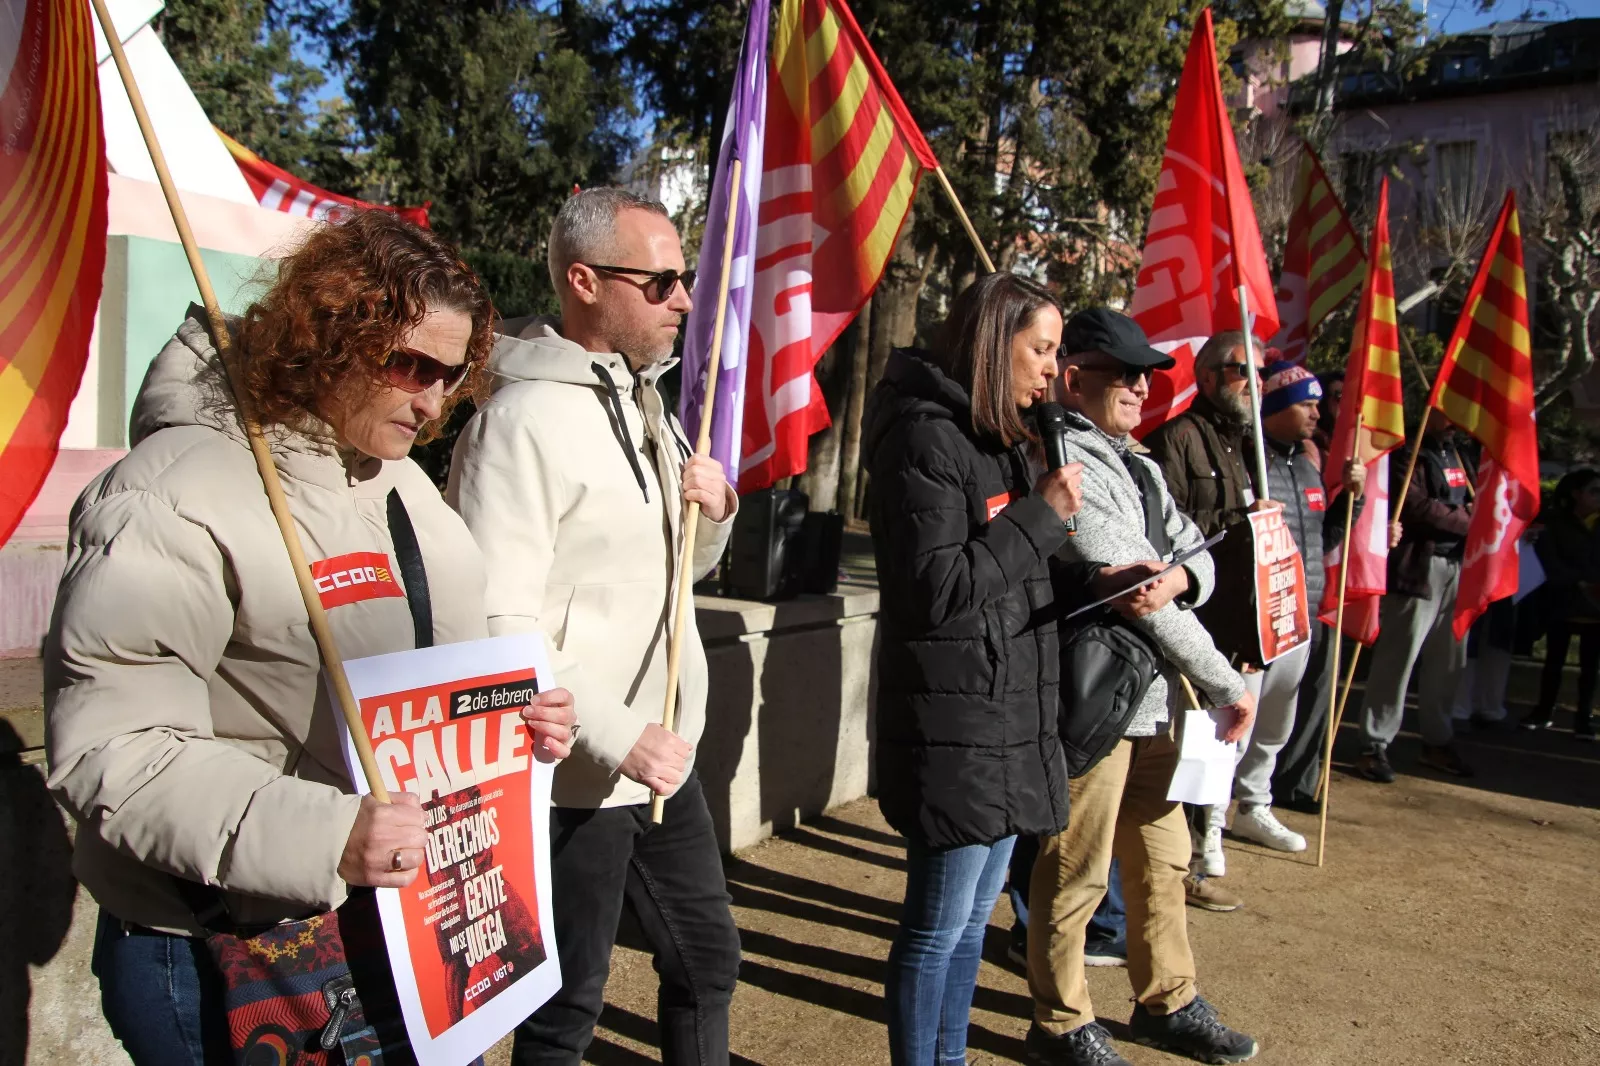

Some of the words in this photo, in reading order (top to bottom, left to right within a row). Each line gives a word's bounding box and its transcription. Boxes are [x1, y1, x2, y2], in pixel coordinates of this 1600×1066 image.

[313, 566, 377, 594] CCOO
[372, 706, 396, 740] A
[402, 695, 444, 732] LA
[456, 694, 472, 714] 2
[472, 691, 488, 711] de
[489, 687, 534, 707] febrero
[374, 711, 528, 804] CALLE
[434, 804, 447, 825] LOS
[425, 807, 500, 875] DERECHOS
[460, 861, 469, 880] DE
[468, 858, 477, 877] LA
[464, 864, 507, 921] GENTE
[449, 936, 460, 956] NO
[459, 930, 467, 950] SE
[465, 910, 507, 968] JUEGA
[464, 977, 491, 1001] CCOO
[493, 965, 508, 982] UGT
